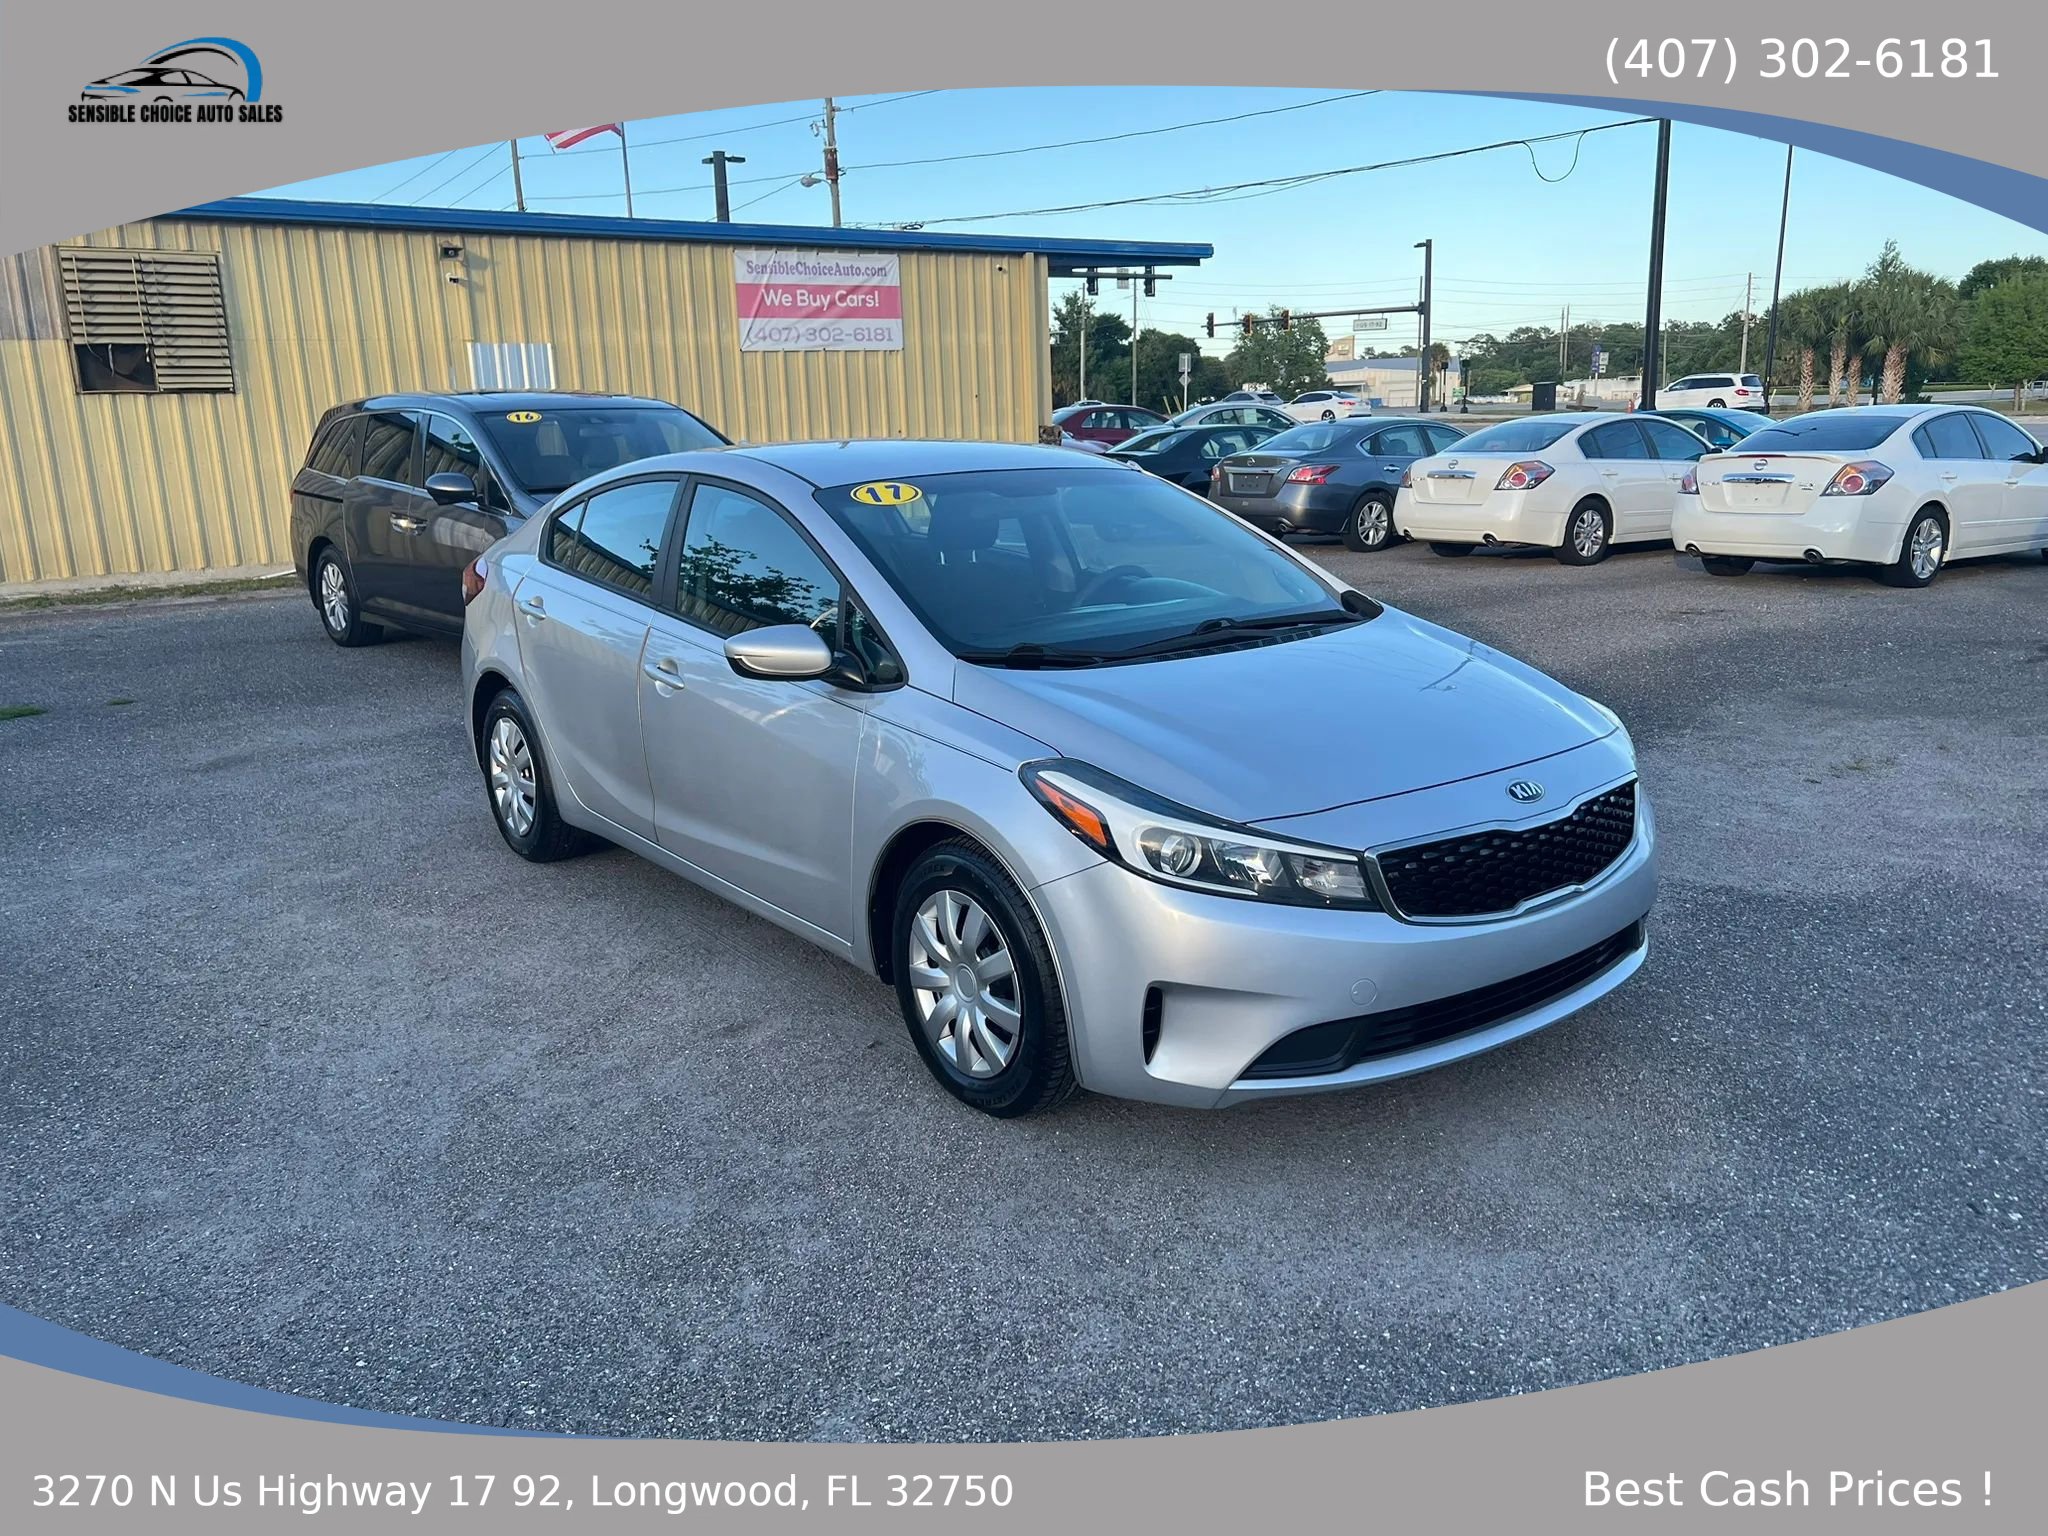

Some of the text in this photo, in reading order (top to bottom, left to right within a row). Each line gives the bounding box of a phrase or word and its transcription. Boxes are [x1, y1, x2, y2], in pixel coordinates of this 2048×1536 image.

[746, 260, 888, 278] SensibleChoiceAuto.com
[762, 289, 880, 311] We Buy Cars!
[747, 327, 894, 344] (407) 302-6181
[515, 413, 534, 421] 16
[865, 484, 902, 503] 17
